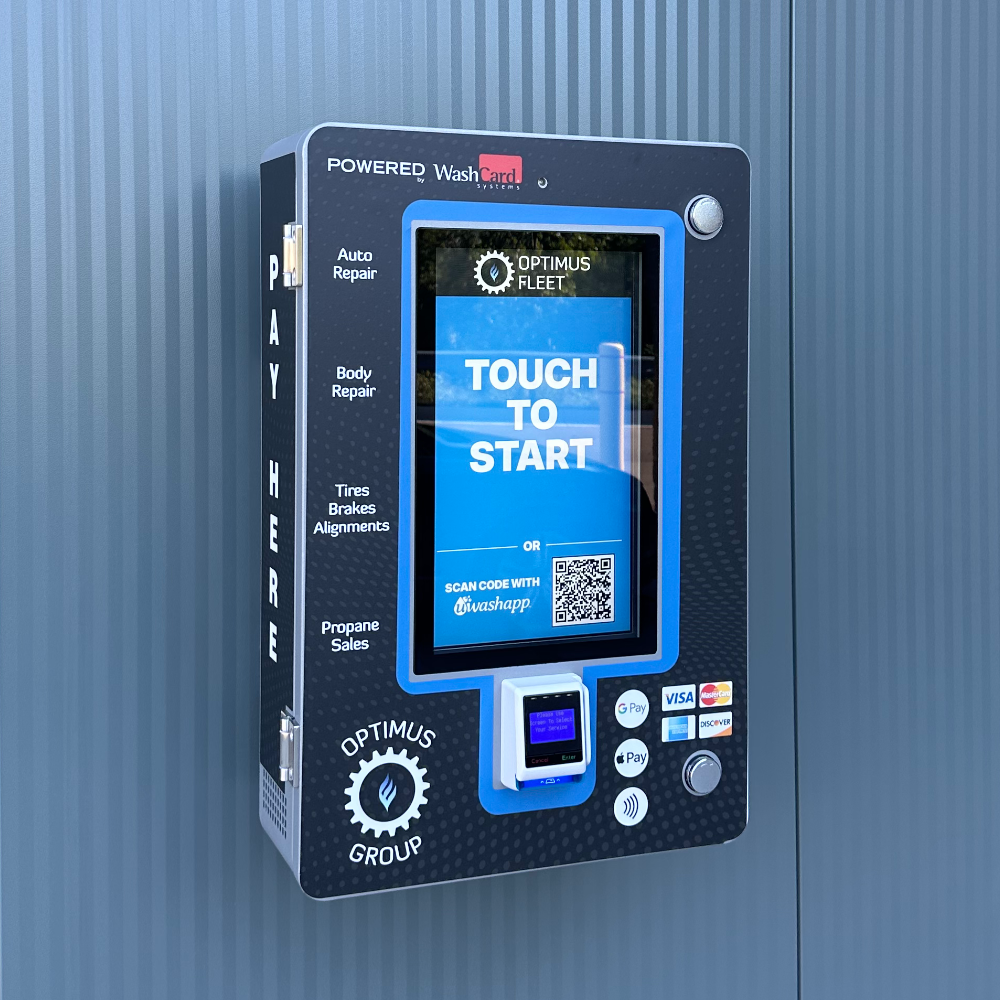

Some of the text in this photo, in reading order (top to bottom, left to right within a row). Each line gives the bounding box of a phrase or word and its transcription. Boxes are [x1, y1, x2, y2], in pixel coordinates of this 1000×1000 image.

[327, 157, 426, 177] POWERED
[433, 162, 520, 183] WashCard
[337, 248, 372, 262] Auto
[518, 256, 591, 272] OPTIMUS
[333, 266, 378, 283] Repair
[518, 276, 566, 290] FLEET
[336, 366, 372, 383] Body
[464, 358, 597, 390] TOUCH
[332, 384, 376, 401] Repair
[506, 398, 558, 430] TO
[470, 438, 593, 472] START
[335, 484, 370, 498] Tires
[328, 501, 376, 516] Brakes
[314, 520, 390, 537] Alignments
[523, 540, 540, 552] OR
[444, 577, 540, 593] SCAN CODE WITH
[322, 621, 380, 636] Propane
[332, 638, 370, 652] Sales
[665, 692, 694, 704] VISA
[630, 702, 647, 714] Pay
[700, 718, 730, 728] DISCOVER
[341, 720, 436, 756] OPTIMUS
[626, 752, 647, 765] Pay
[349, 836, 422, 866] GROUP
